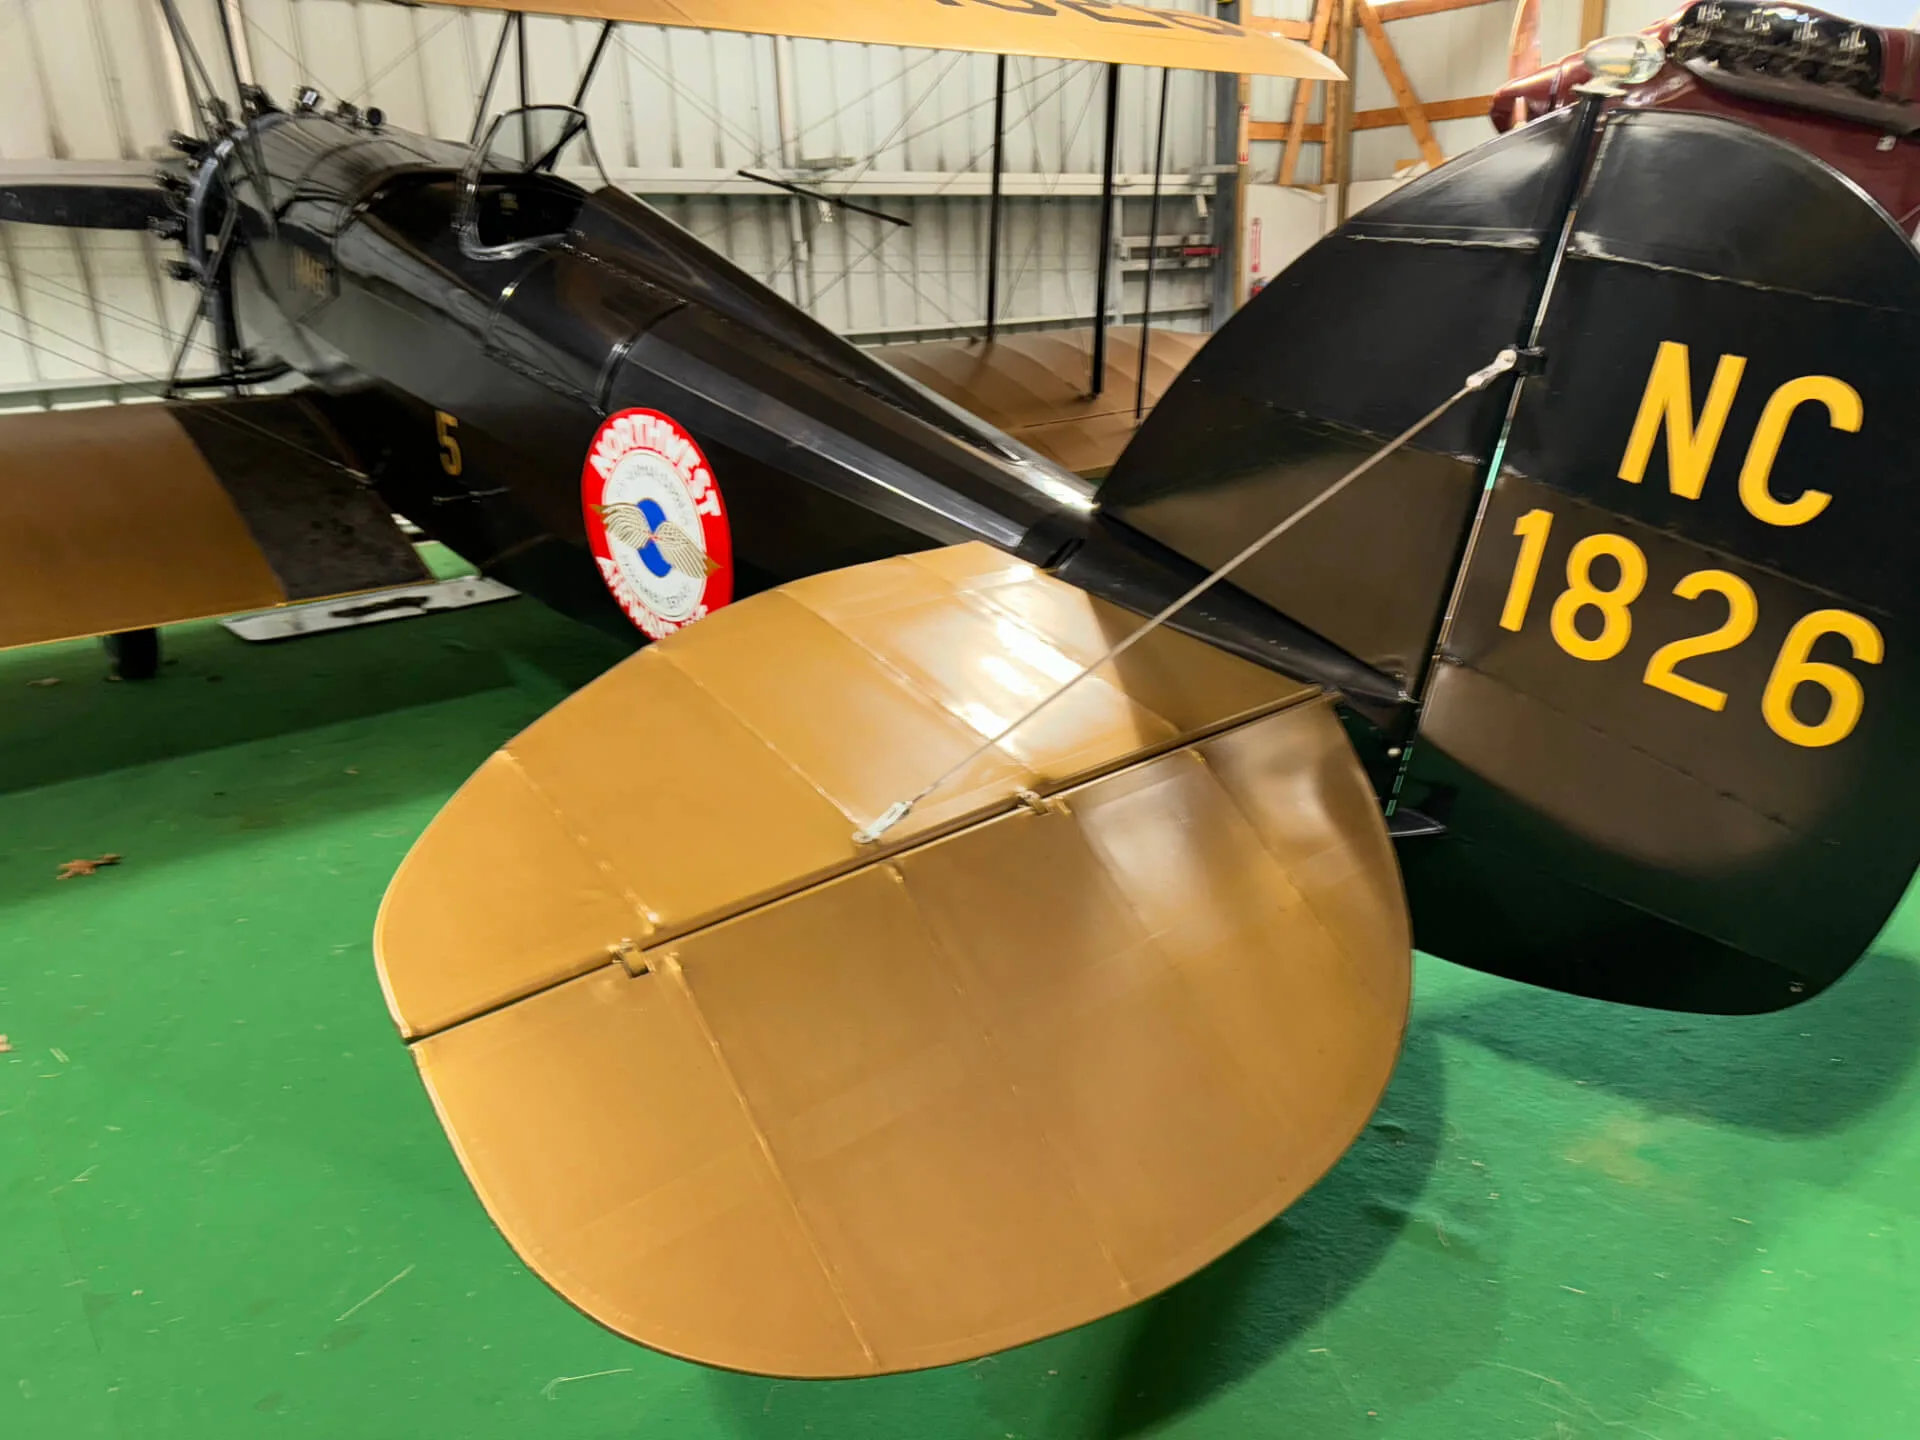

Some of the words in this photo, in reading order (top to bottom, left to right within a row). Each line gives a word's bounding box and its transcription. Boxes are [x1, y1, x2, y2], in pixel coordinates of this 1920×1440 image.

[435, 410, 462, 476] 5
[590, 414, 722, 516] NORTHWEST
[1617, 340, 1864, 527] NC
[1499, 508, 1885, 747] 1826
